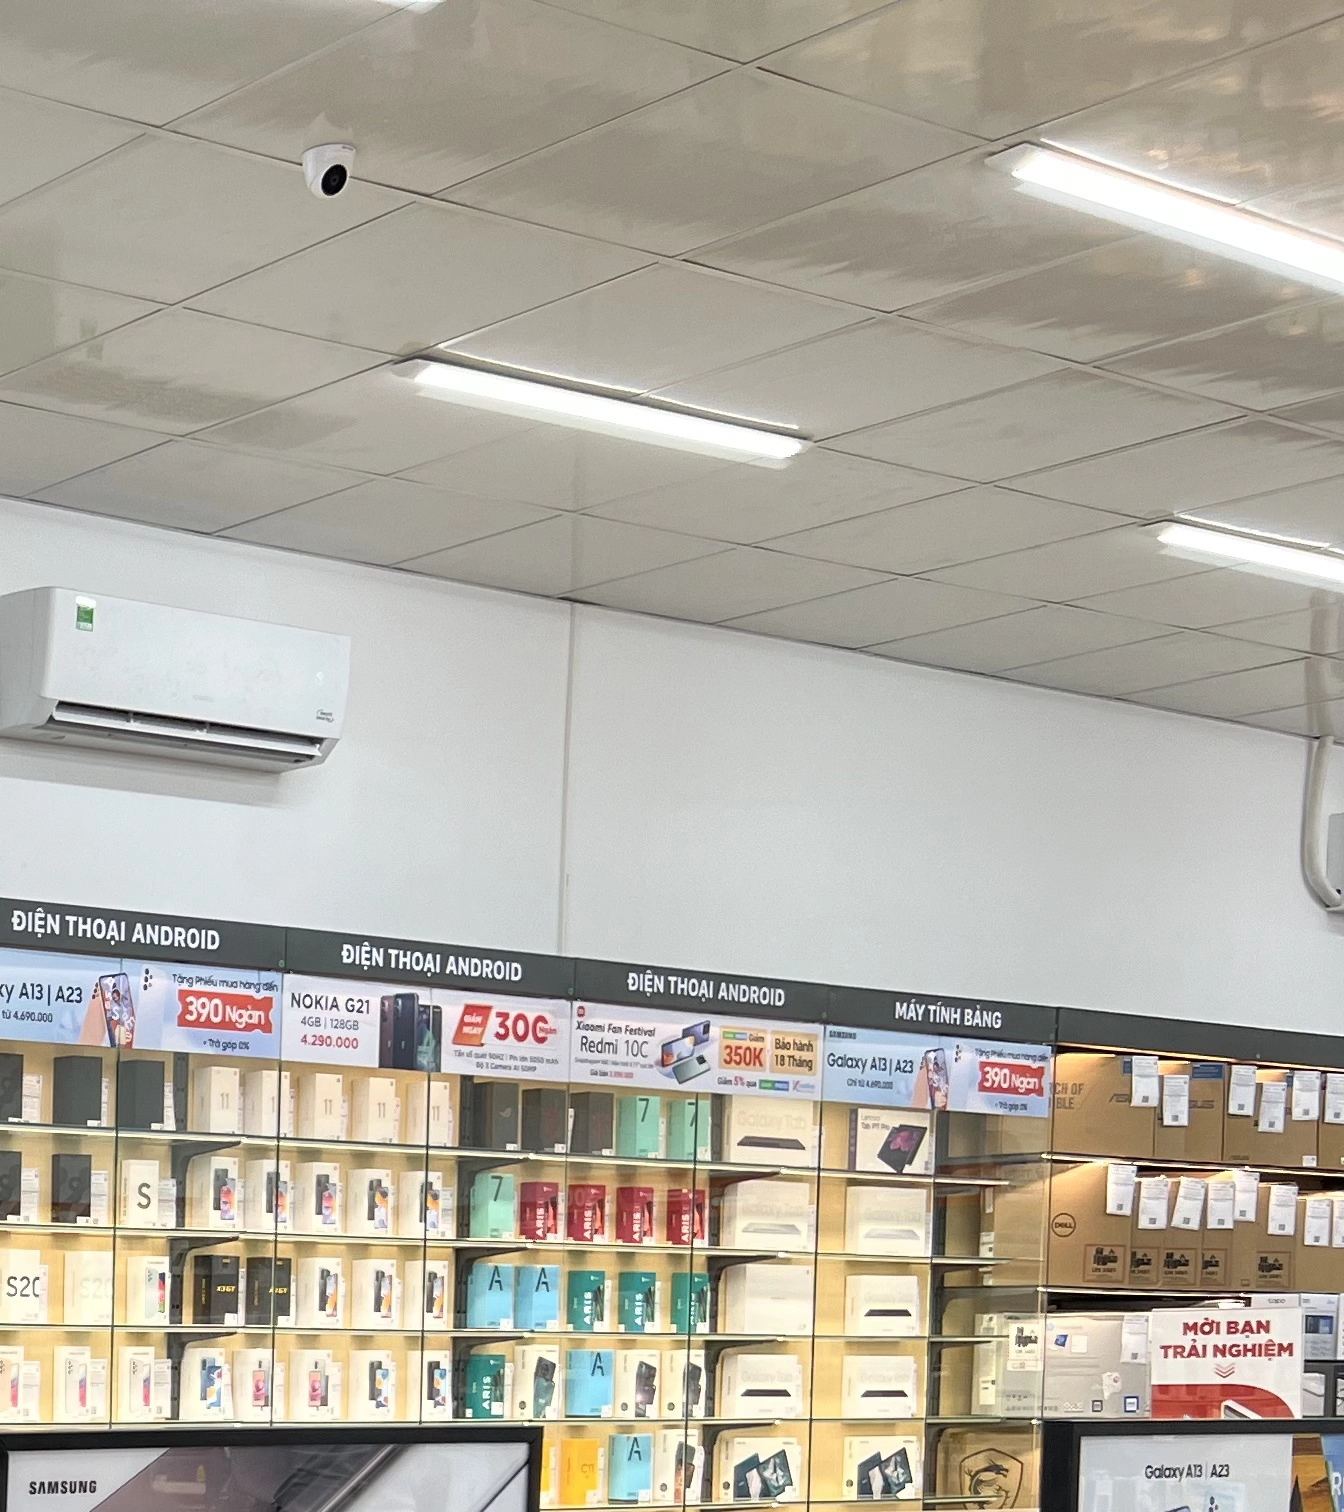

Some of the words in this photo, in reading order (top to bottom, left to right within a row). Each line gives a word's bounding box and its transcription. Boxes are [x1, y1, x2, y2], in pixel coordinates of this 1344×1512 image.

[11, 906, 61, 939] ĐIỆN
[65, 914, 126, 947] THOẠI
[131, 921, 221, 951] ANDROID
[341, 941, 384, 971] ĐIỆN
[388, 948, 441, 978] THOẠI
[445, 954, 522, 982] ANDROID
[18, 982, 44, 1001] A13
[54, 985, 83, 1004] A23
[627, 969, 665, 997] ĐIỆN
[667, 976, 713, 1003] THOẠI
[718, 983, 786, 1007] ANDROID
[184, 995, 223, 1024] 390
[225, 1004, 265, 1029] Ngàn
[290, 992, 340, 1012] NOKIA
[345, 997, 370, 1014] G21
[895, 999, 928, 1021] MÁY
[929, 1000, 961, 1025] TÍNH
[964, 1002, 1002, 1029] BẢNG
[12, 1011, 53, 1023] 4.690.000
[300, 1016, 322, 1028] 4GB
[329, 1018, 360, 1031] 128GB
[300, 1033, 359, 1050] 4.290.000
[607, 1023, 623, 1034] Fan
[624, 1025, 656, 1037] Festival
[580, 1035, 618, 1056] Redmi
[624, 1040, 649, 1059] 10C
[774, 1036, 792, 1051] Bảo
[792, 1037, 814, 1052] hành
[723, 1044, 764, 1068] 350K
[774, 1054, 785, 1067] 18
[787, 1054, 813, 1072] Tháng
[826, 1052, 868, 1075] Galaxy
[869, 1056, 888, 1072] A13
[894, 1059, 914, 1074] A23
[983, 1066, 1010, 1089] 390
[1010, 1073, 1039, 1093] Ngàn
[638, 1098, 650, 1123] 7
[136, 1182, 152, 1210] S
[490, 1175, 504, 1202] 7
[1182, 1317, 1221, 1337] MỜI
[1226, 1319, 1271, 1338] BẠN
[1159, 1338, 1207, 1359] TRẢI
[1212, 1338, 1294, 1361] NGHIỆM
[1144, 1464, 1185, 1482] Galaxy
[1185, 1463, 1203, 1478] A13
[1210, 1463, 1230, 1478] A23
[28, 1479, 98, 1496] SAMSUNG
